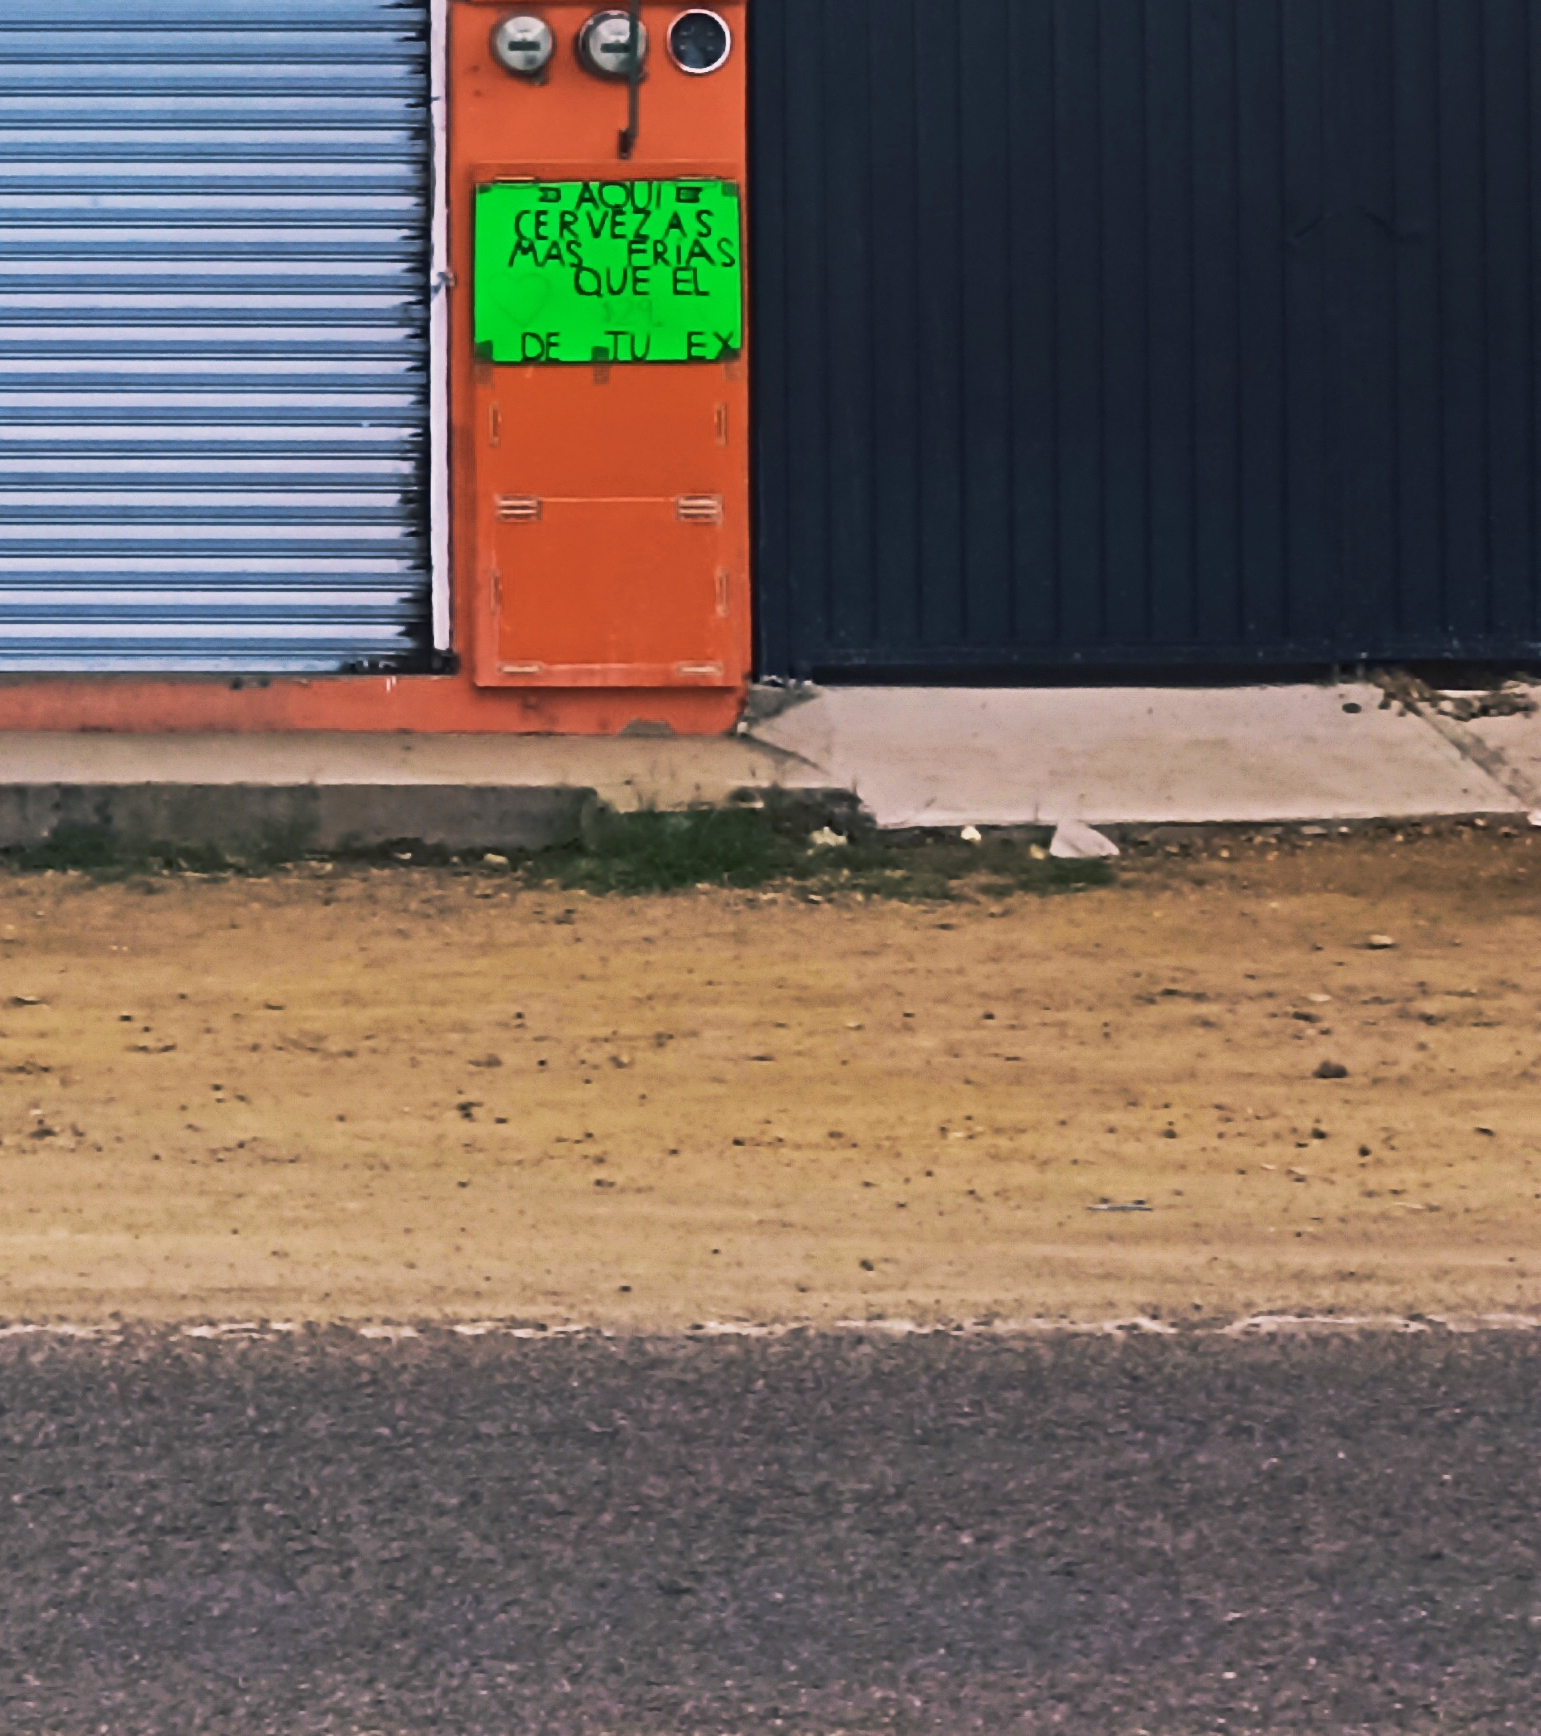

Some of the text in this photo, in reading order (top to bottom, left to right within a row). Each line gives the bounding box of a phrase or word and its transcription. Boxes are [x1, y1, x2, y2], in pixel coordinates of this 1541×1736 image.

[576, 182, 662, 214] AQUI
[514, 210, 714, 241] CERVEZAS
[509, 238, 736, 268] MAS FRIAS
[574, 266, 710, 298] QUE EL
[521, 330, 733, 362] DE TU EX
